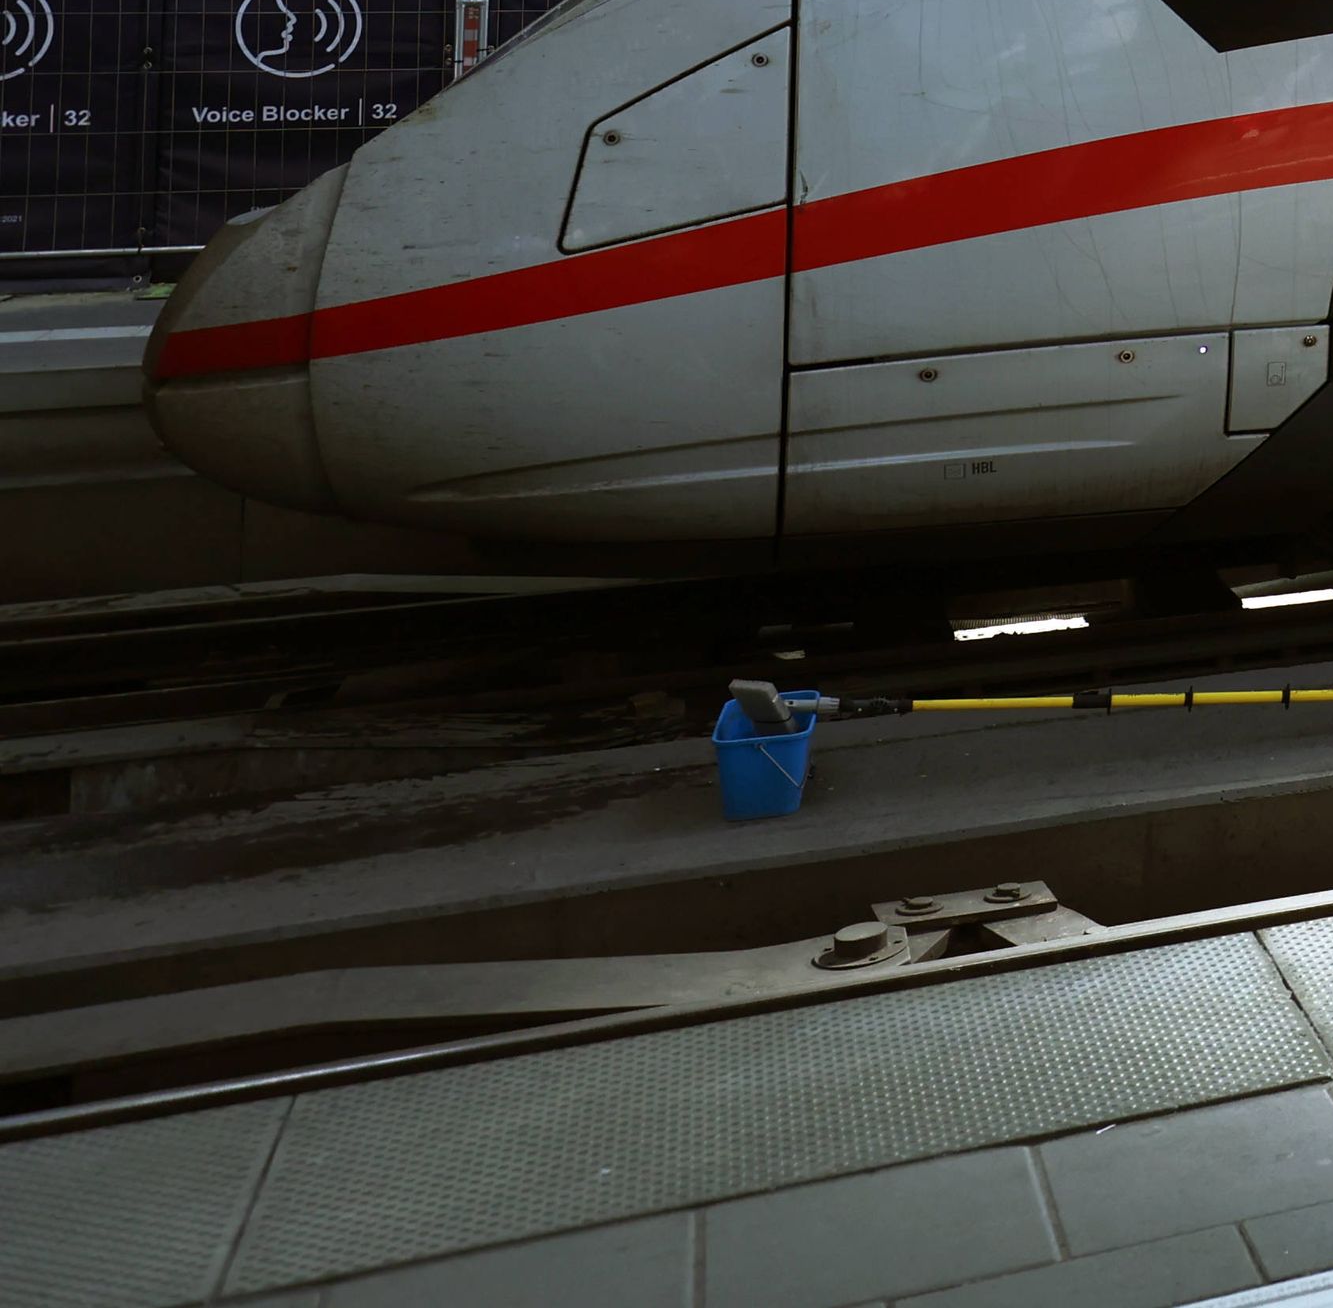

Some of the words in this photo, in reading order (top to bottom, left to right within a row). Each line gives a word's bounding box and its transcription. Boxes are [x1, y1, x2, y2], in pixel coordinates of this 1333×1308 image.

[0, 110, 40, 127] ker
[64, 109, 92, 126] 32
[192, 106, 255, 123] Voice
[262, 104, 350, 122] Blocker
[372, 103, 398, 119] 32
[972, 460, 997, 475] HBL
